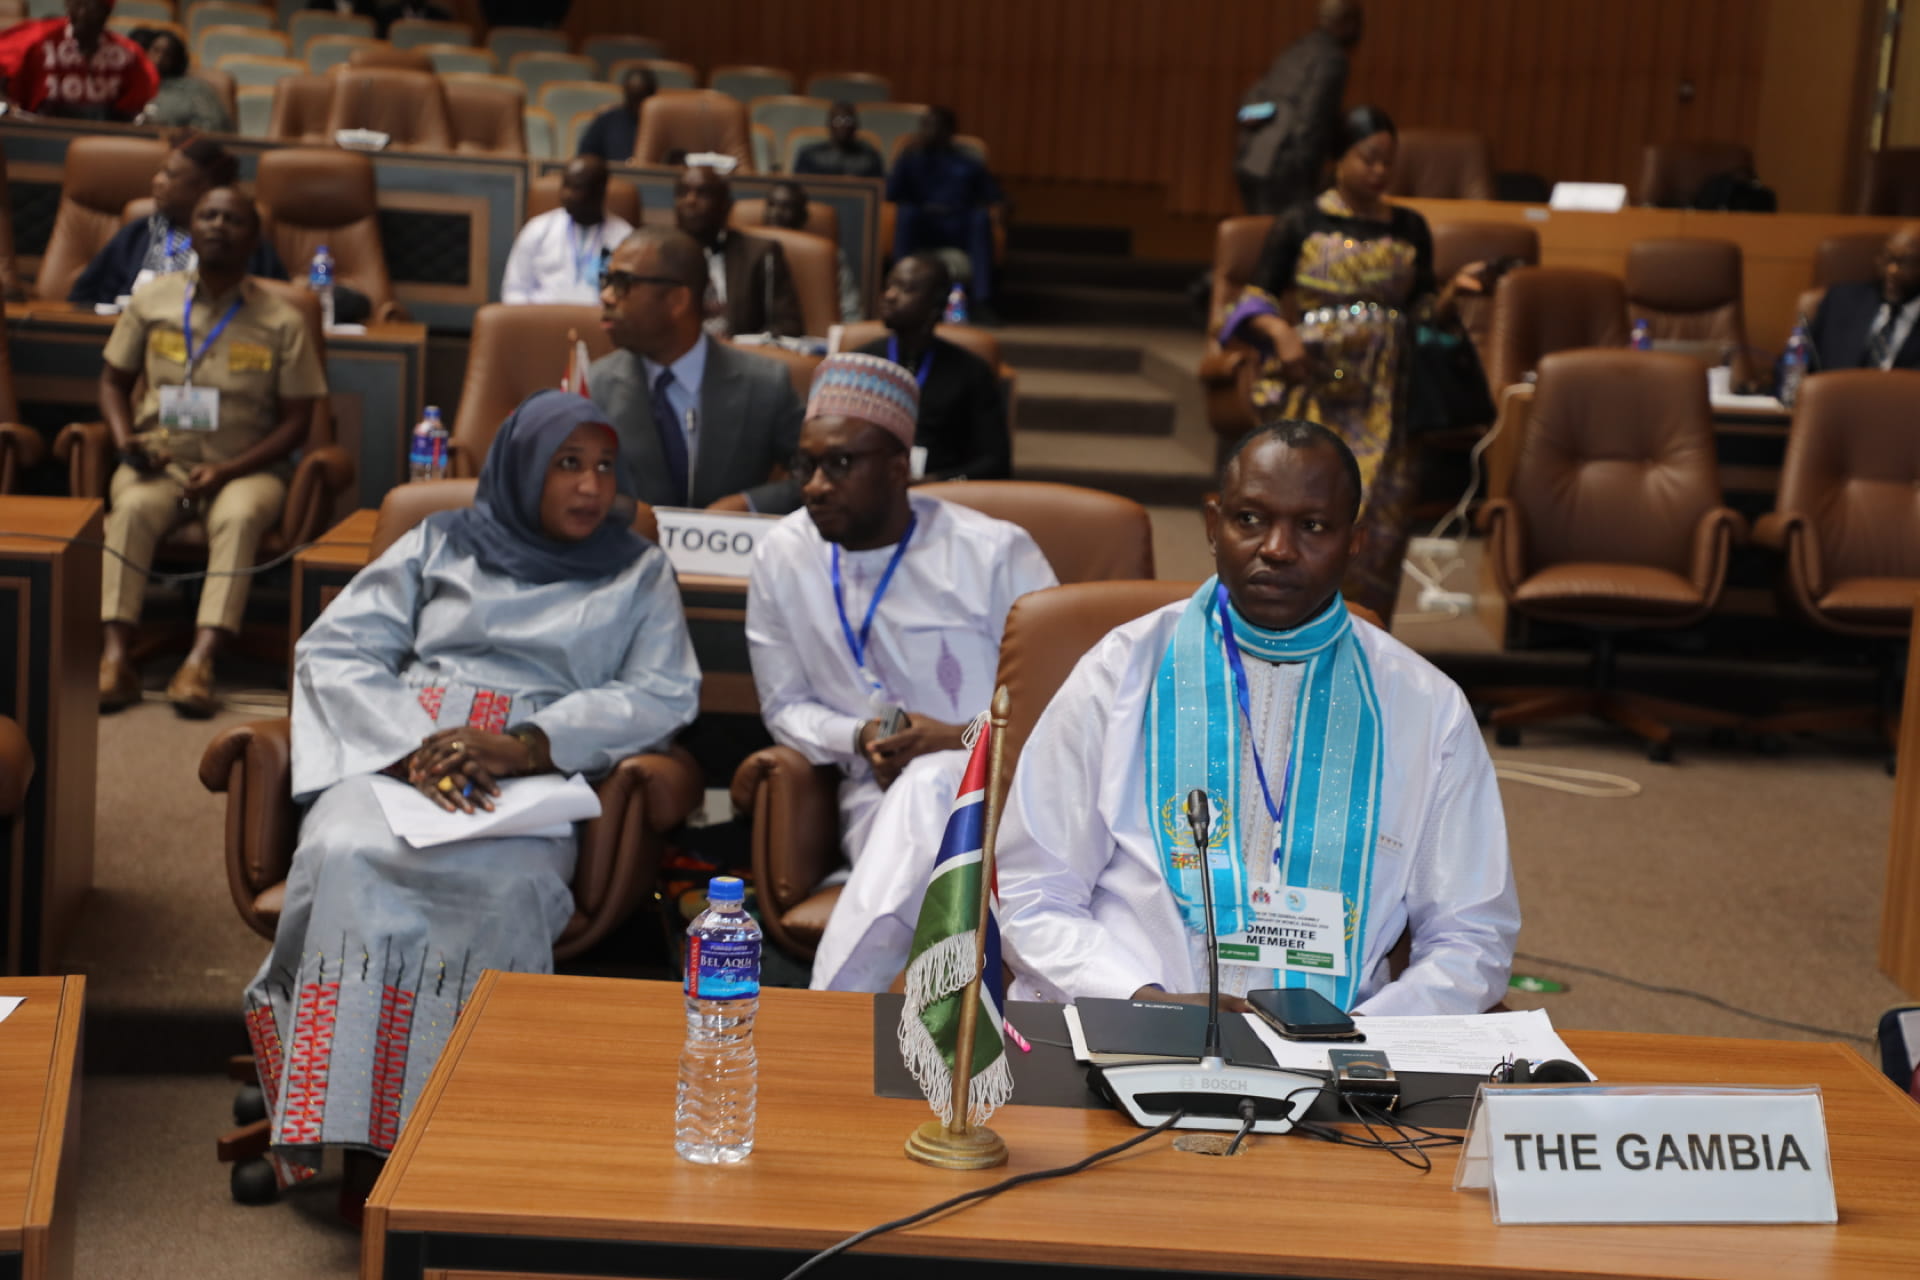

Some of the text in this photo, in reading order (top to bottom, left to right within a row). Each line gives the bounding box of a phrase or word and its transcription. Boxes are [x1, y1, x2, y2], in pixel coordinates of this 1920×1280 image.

[664, 526, 754, 554] TOGO
[1246, 925, 1316, 940] OMMITTEE
[1246, 935, 1305, 949] MEMBER
[701, 954, 720, 967] BEL
[1201, 1078, 1248, 1091] BOSCH
[1504, 1133, 1812, 1171] THE GAMBIA
